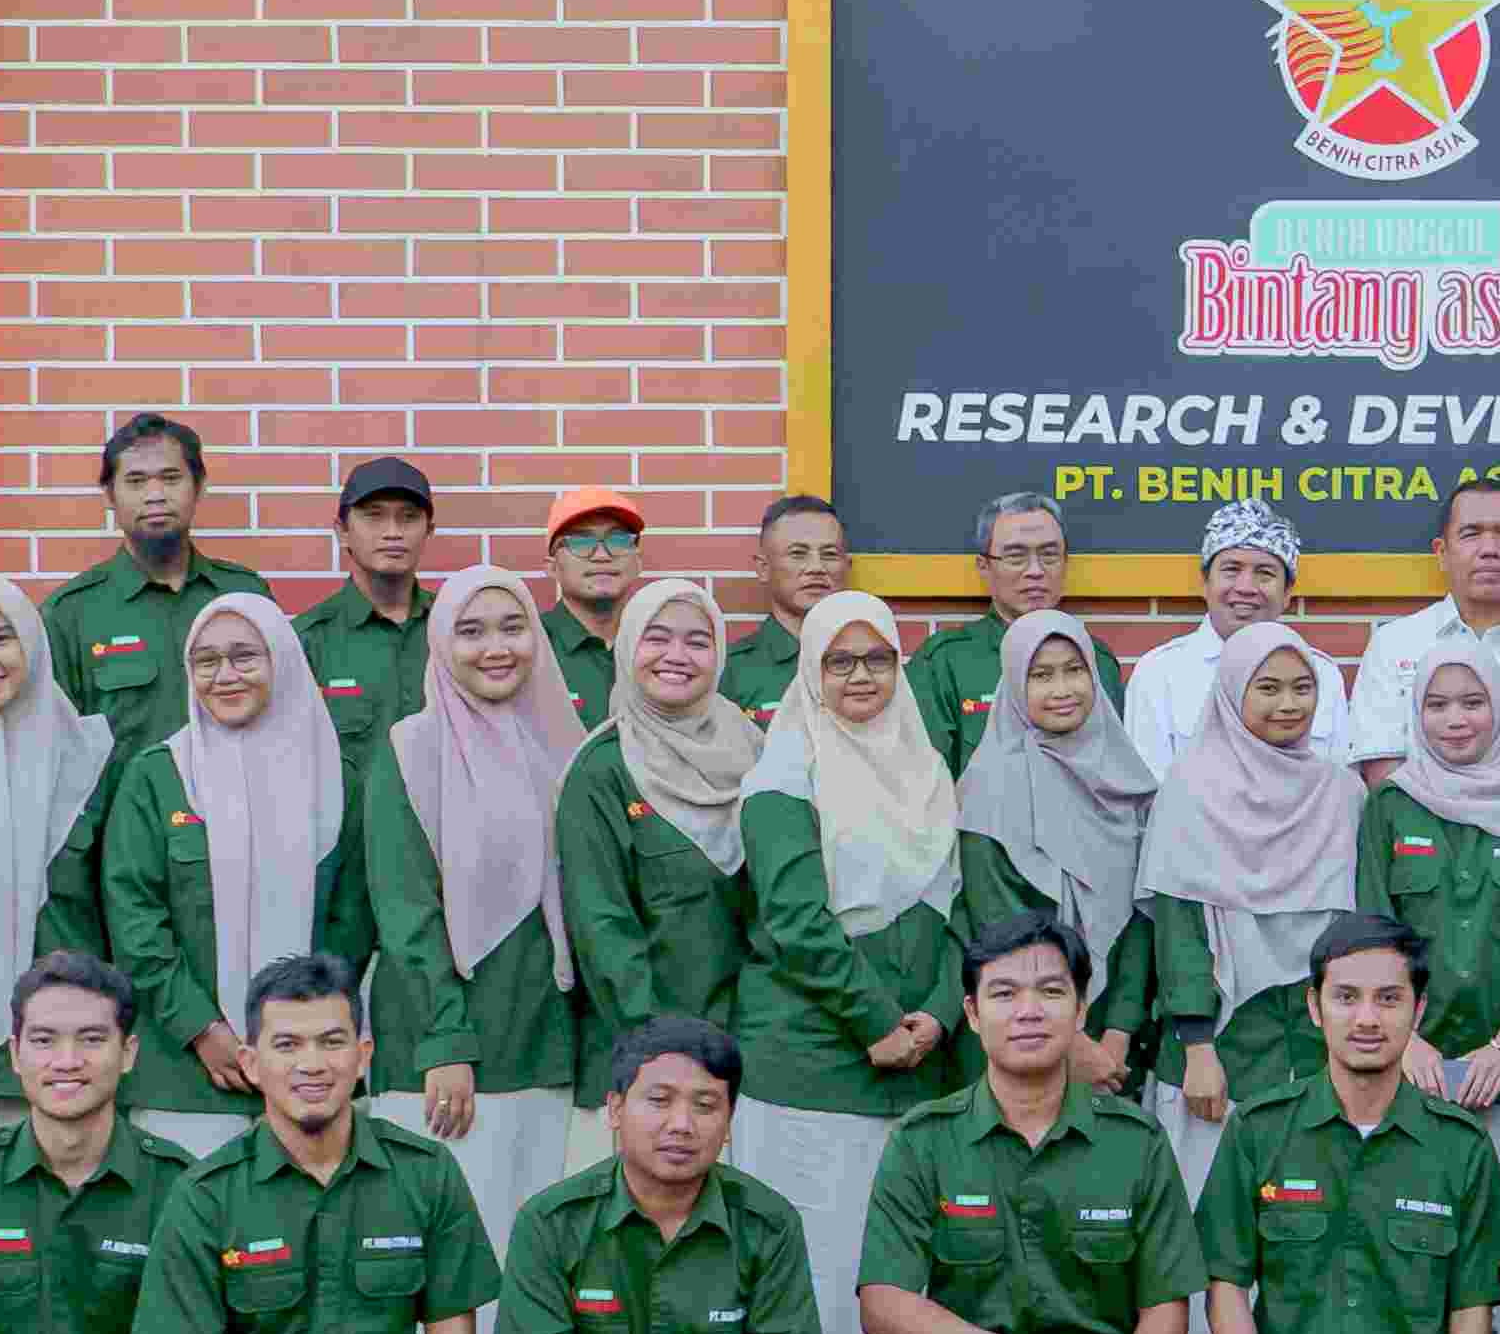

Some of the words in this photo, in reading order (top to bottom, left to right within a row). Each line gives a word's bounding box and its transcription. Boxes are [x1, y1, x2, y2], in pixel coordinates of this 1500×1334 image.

[1305, 130, 1362, 169] BENIH
[1365, 152, 1421, 171] CITRA
[1425, 132, 1467, 163] ASIA
[1180, 242, 1426, 368] Bintang
[897, 392, 1263, 444] RESEARCH
[1281, 393, 1327, 444] &
[1055, 466, 1123, 501] PT.
[1138, 466, 1283, 502] BENIH
[1299, 466, 1436, 501] CITRA
